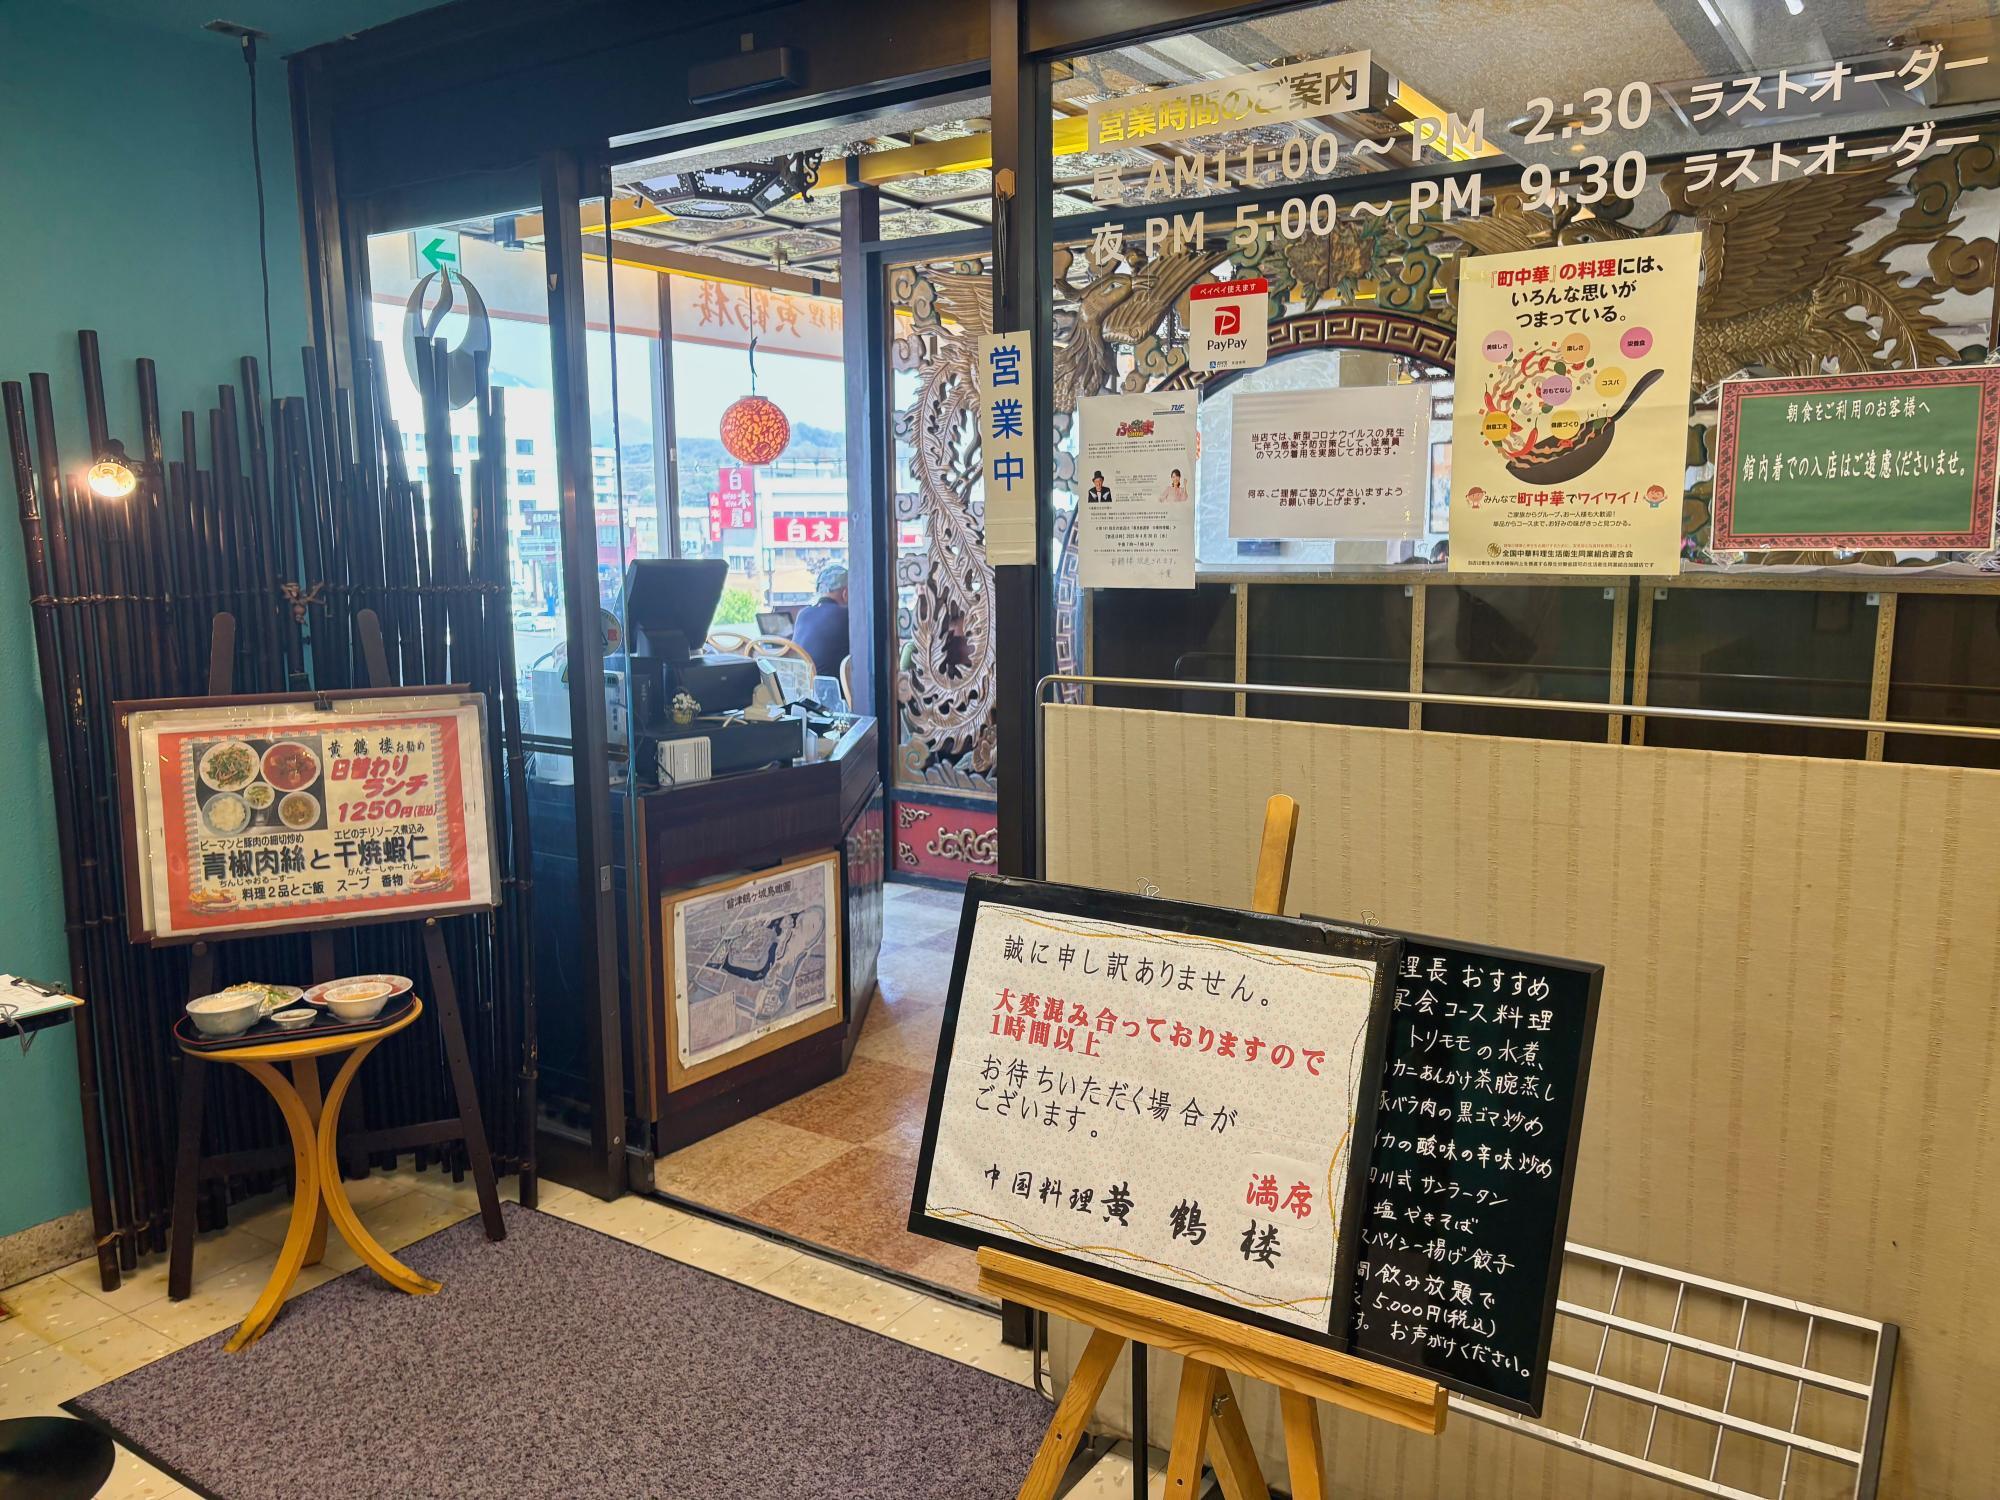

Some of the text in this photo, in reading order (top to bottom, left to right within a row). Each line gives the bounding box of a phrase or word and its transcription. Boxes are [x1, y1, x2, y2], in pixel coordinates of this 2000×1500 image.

[1097, 66, 1358, 142] 営業時間のご案内
[1143, 132, 1339, 198] AM11:00
[1411, 108, 1485, 161] PM
[1524, 82, 1652, 144] 2:30
[1689, 43, 1989, 122] ラストオーダー
[1091, 222, 1125, 265] 夜
[1145, 211, 1204, 257] PM
[1235, 194, 1337, 245] 5:00
[1409, 173, 1482, 224] PM
[1520, 151, 1647, 211] 9:30
[1683, 121, 1980, 192] ラストオーダー
[1490, 256, 1664, 288] 『町中華』の料理には、
[1200, 283, 1257, 295] ペイペイ使えます
[1512, 280, 1636, 307] いろんな思いが
[1516, 305, 1626, 328] つまっている。
[1207, 338, 1247, 352] PayPay
[1542, 386, 1570, 395] おもてなし
[1602, 379, 1620, 387] コスパ
[990, 345, 1024, 492] 営業中
[1787, 396, 1931, 424] 朝食をご利用のお客様へ
[1251, 428, 1405, 443] 当店では、新型コロナウイルスの発生
[1551, 420, 1579, 429] 健康づくり
[1254, 437, 1400, 450] に伴う感染予防対策として、従業員
[1256, 446, 1397, 460] のマスク着用を実施しております。
[1743, 449, 1966, 483] 館内着での入店はご遠慮くださいませ。
[1248, 487, 1403, 499] 何卒、ご理解ご協力くださいますよう
[1279, 497, 1366, 507] お願い申し上げます。
[331, 754, 408, 781] 日替わり
[362, 774, 428, 799] ランチ
[200, 834, 304, 851] ピーマンと豚肉の細切炒め
[334, 823, 425, 840] エビのチリソース煮込み
[337, 877, 370, 892] スープ
[1003, 934, 1269, 1008] 誠に申し訳ありません。
[1462, 965, 1550, 1001] おすすめ
[989, 1013, 1101, 1058] 1時間以上
[994, 987, 1326, 1076] 大変混み合っておりますので
[980, 1053, 1238, 1133] お待ちいただく場合が
[974, 1085, 1099, 1139] ございます。
[1246, 1173, 1313, 1220] 満席
[1391, 1320, 1530, 1377] お声がけください。
